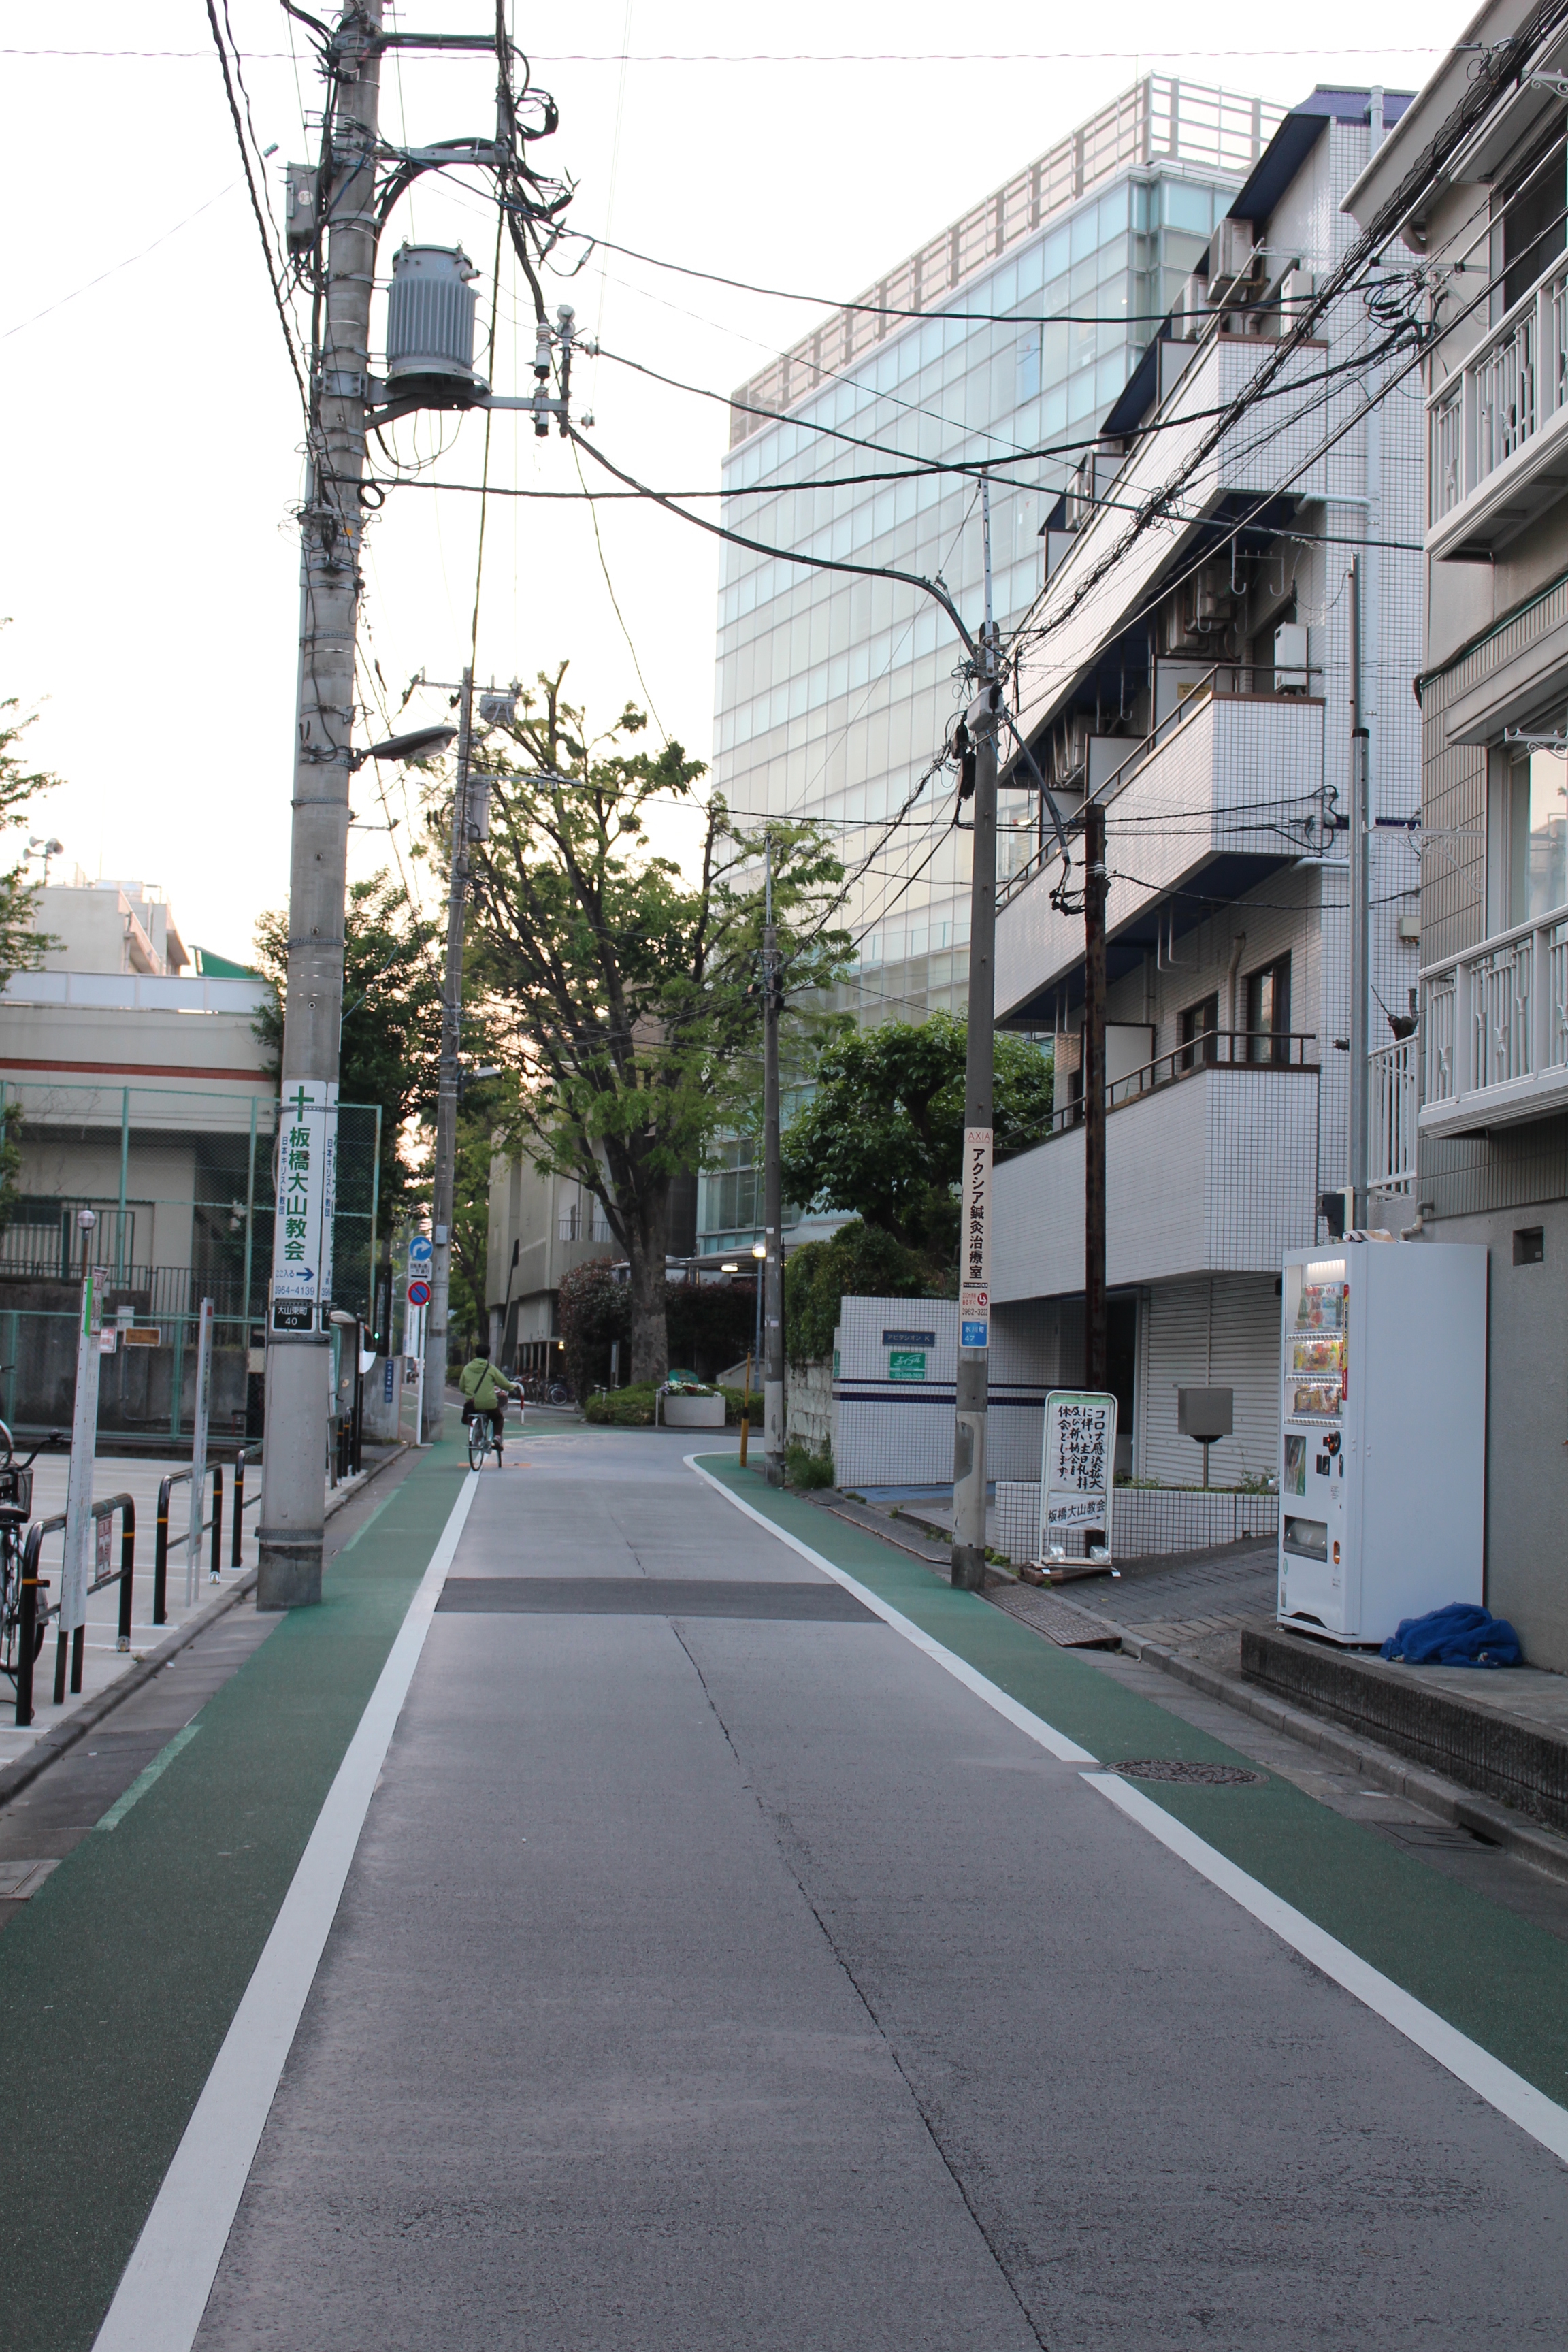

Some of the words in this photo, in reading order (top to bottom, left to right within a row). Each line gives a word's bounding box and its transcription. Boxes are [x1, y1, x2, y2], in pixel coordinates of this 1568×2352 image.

[968, 1131, 990, 1141] AXIA
[278, 1136, 288, 1215] 日本キリスト教団
[325, 1139, 333, 1218] 日本キリスト教団
[284, 1126, 311, 1261] 板橋大山教会
[968, 1148, 985, 1279] アクシア鍼灸治療室
[276, 1269, 295, 1278] ここ入る
[275, 1285, 315, 1296] 3964-4139
[277, 1306, 308, 1316] 大山東町
[962, 1307, 988, 1316] 3962-3222
[284, 1318, 298, 1326] 40
[893, 1354, 921, 1366] エイブル
[1057, 1405, 1072, 1481] 休会とします。
[1077, 1407, 1094, 1490] に伴い、主日礼拝
[1048, 1499, 1106, 1523] 板橋大山教会
